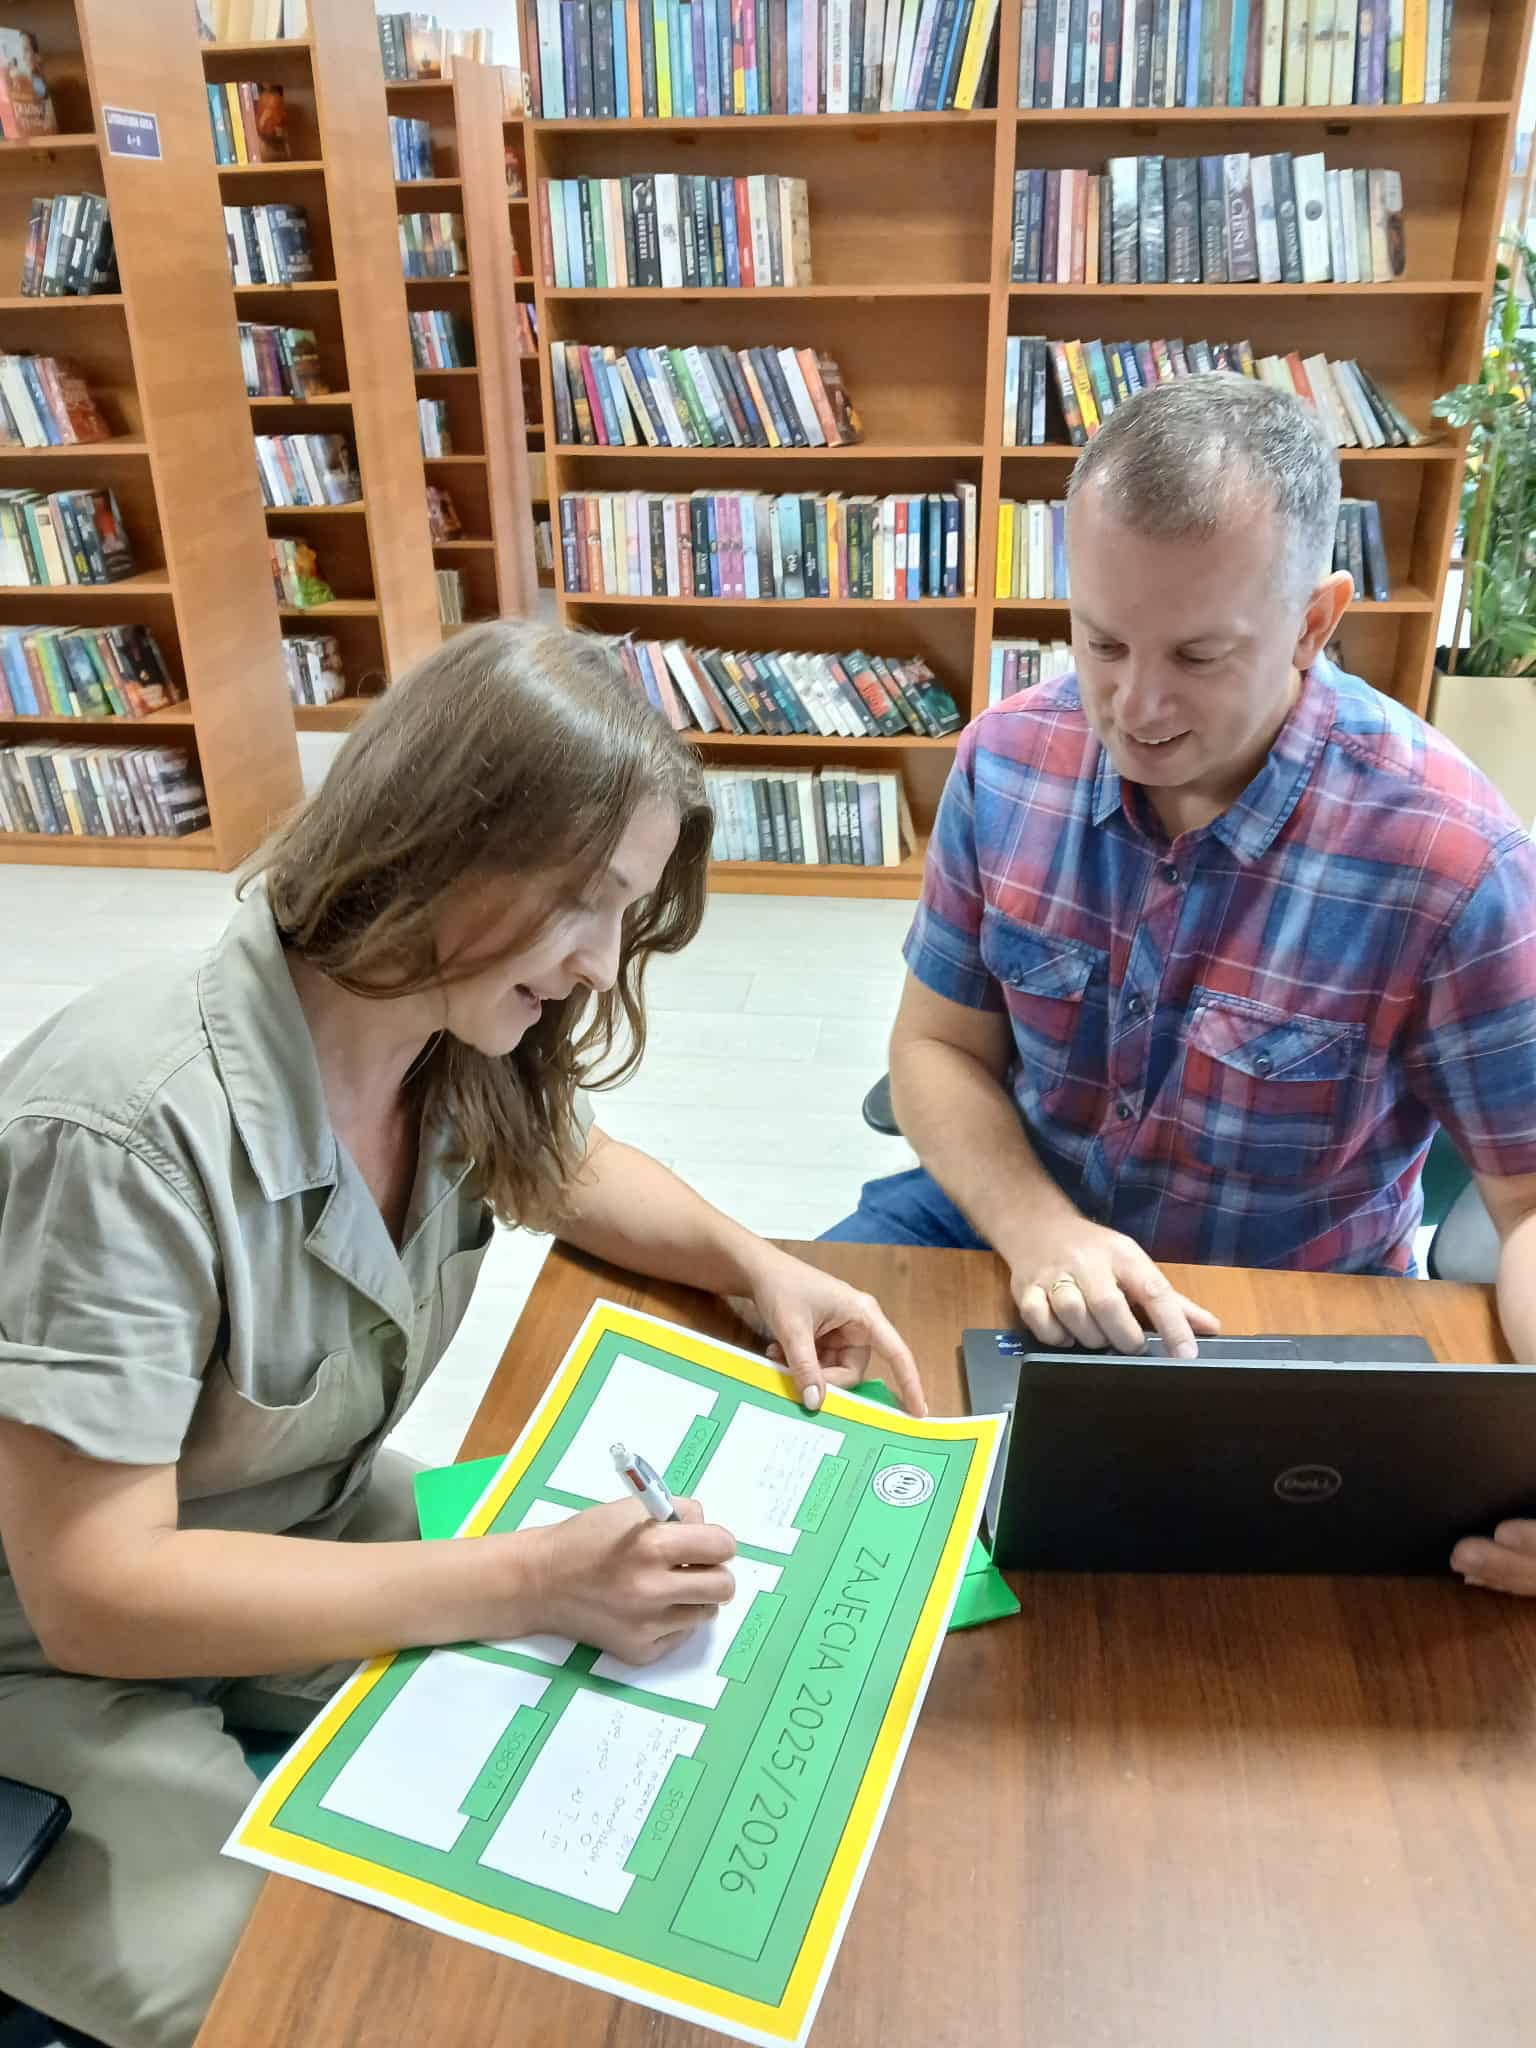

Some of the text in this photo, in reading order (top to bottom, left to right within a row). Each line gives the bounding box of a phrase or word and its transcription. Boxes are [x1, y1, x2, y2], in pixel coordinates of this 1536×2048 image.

[486, 1731, 526, 1790] SOBOTA
[718, 1546, 891, 1895] ZAJĘCIA 2025/2026
